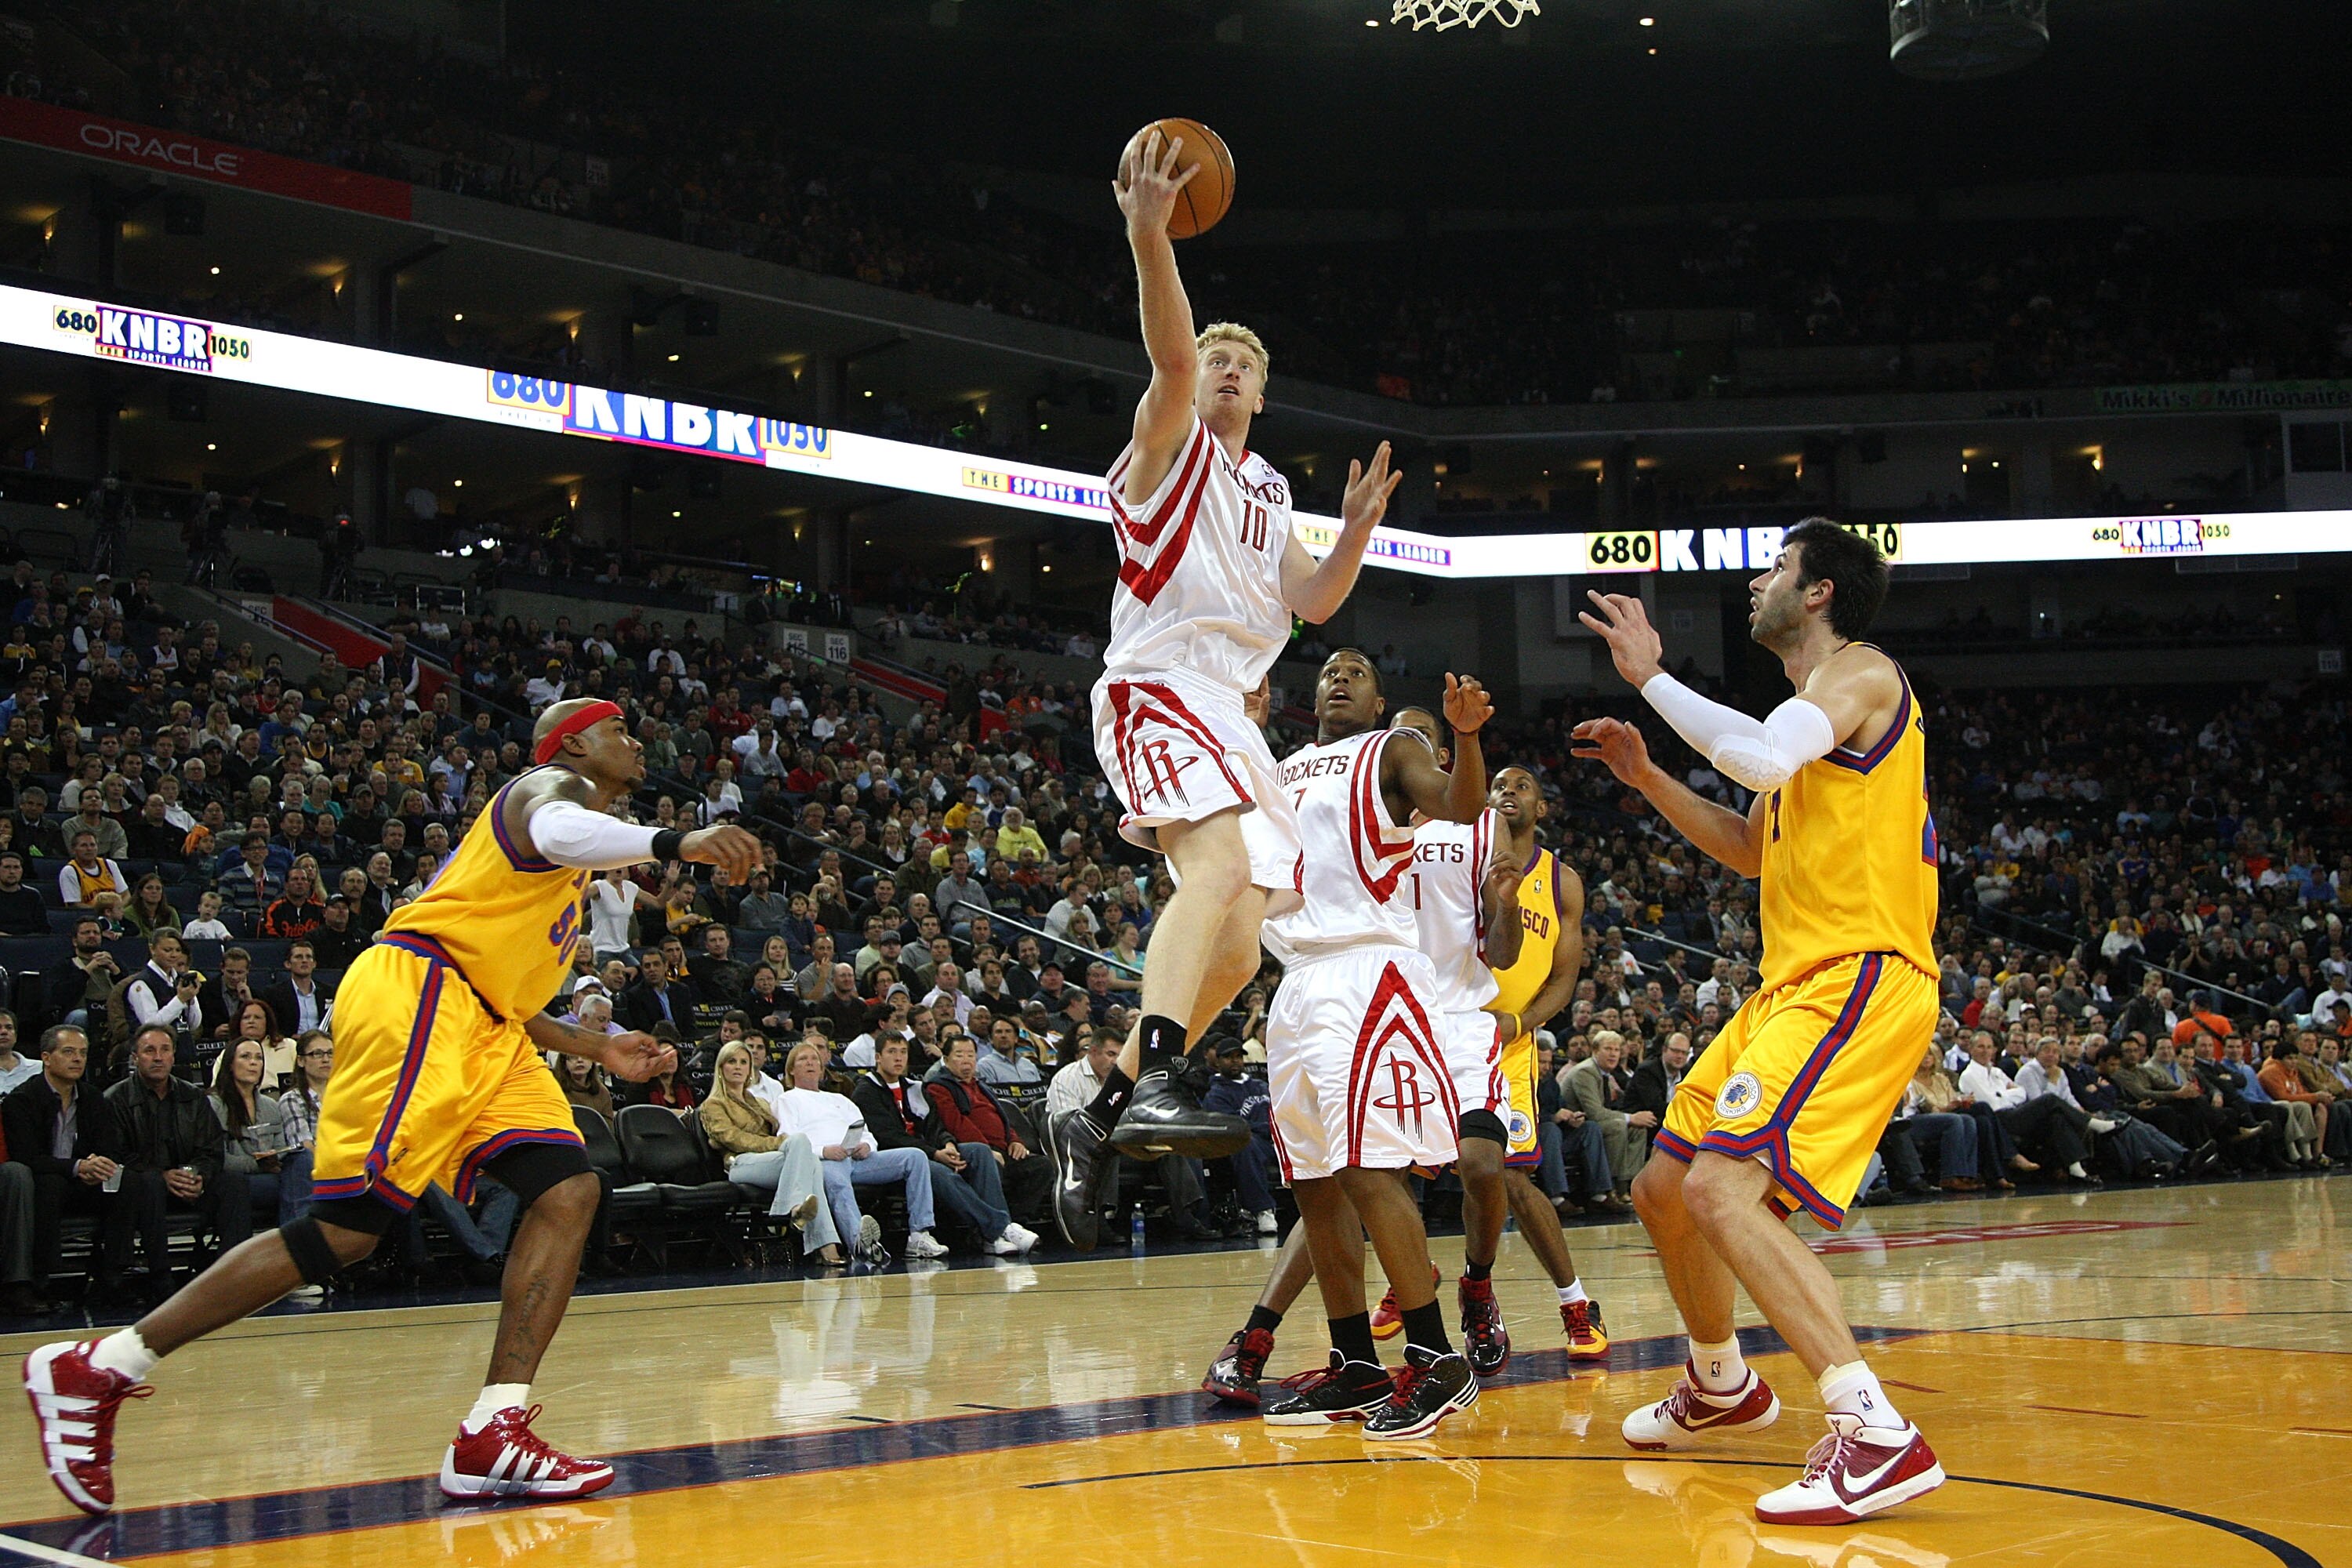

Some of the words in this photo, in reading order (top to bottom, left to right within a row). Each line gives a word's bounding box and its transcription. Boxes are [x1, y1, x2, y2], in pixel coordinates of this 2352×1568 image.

[80, 124, 238, 176] ORACLE
[56, 310, 97, 333] 680
[102, 309, 207, 360] KNBR
[211, 336, 249, 359] 1050
[492, 370, 565, 408] 680
[575, 385, 757, 456] KNBR
[2103, 390, 2192, 408] Mikki's
[971, 470, 998, 488] THE
[1013, 477, 1077, 503] SPORTS
[1240, 499, 1268, 552] 10
[2092, 528, 2119, 541] 680
[2122, 520, 2199, 547] KNBR
[2201, 524, 2230, 539] 1050
[1305, 528, 1328, 543] THE
[1396, 542, 1446, 564] LEADER
[1591, 535, 1651, 566] 680
[828, 647, 847, 660] 116
[829, 637, 844, 646] SEC
